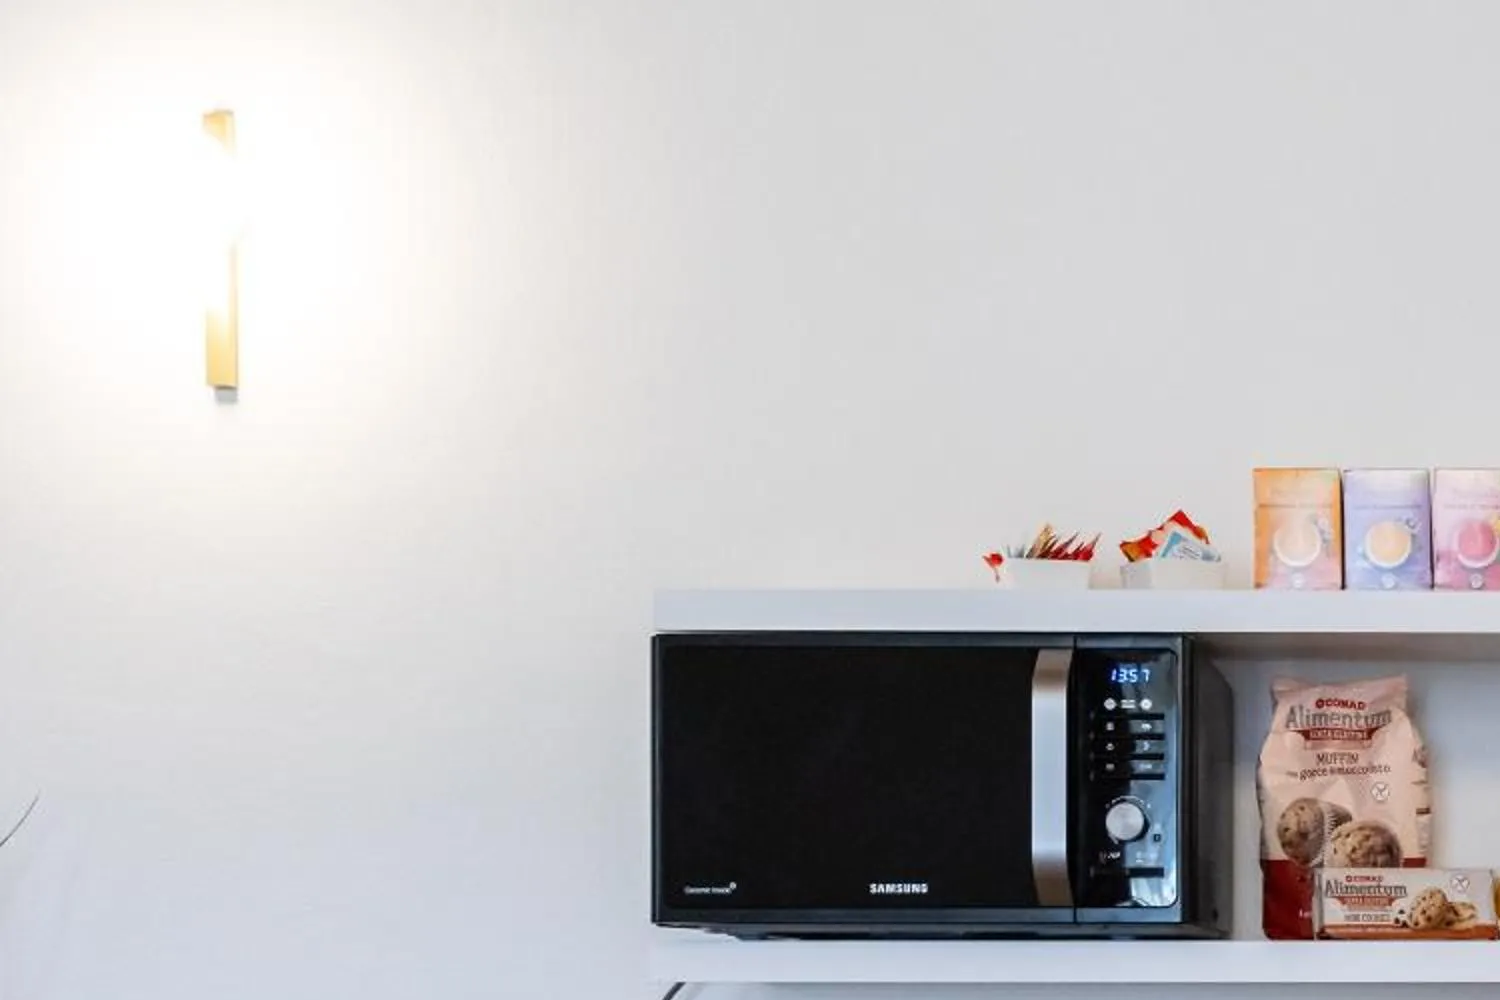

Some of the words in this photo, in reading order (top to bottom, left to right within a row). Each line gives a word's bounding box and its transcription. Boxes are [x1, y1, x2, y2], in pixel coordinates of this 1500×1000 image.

[1285, 704, 1392, 728] Alimentum
[1316, 752, 1359, 765] MUFFIN
[869, 883, 929, 894] SAMSUNG
[1325, 880, 1407, 897] Alimentum
